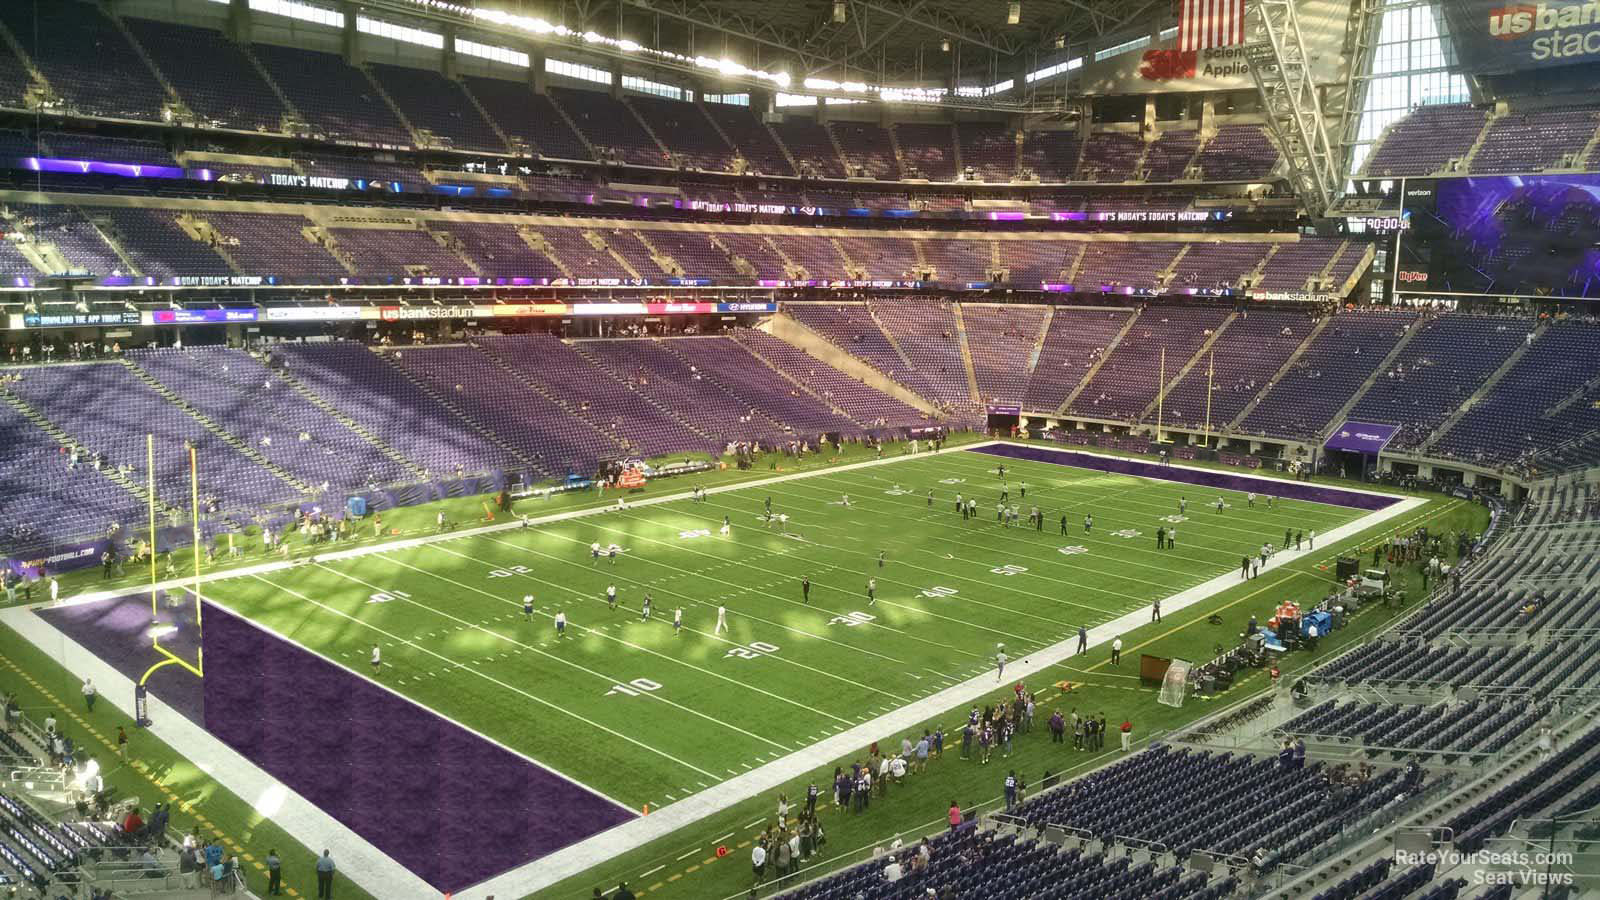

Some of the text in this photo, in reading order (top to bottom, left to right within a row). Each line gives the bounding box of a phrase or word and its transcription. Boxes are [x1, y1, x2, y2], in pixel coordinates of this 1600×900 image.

[1203, 62, 1253, 77] Applie
[271, 174, 348, 189] TODAY'S MATCHUP
[759, 205, 785, 214] MATCHUP
[1149, 211, 1175, 221] TODAY'S
[1178, 212, 1208, 221] MATCHUP
[201, 276, 229, 286] TODAY'S
[88, 315, 100, 323] APP
[727, 641, 780, 660] 20
[612, 677, 664, 697] 10
